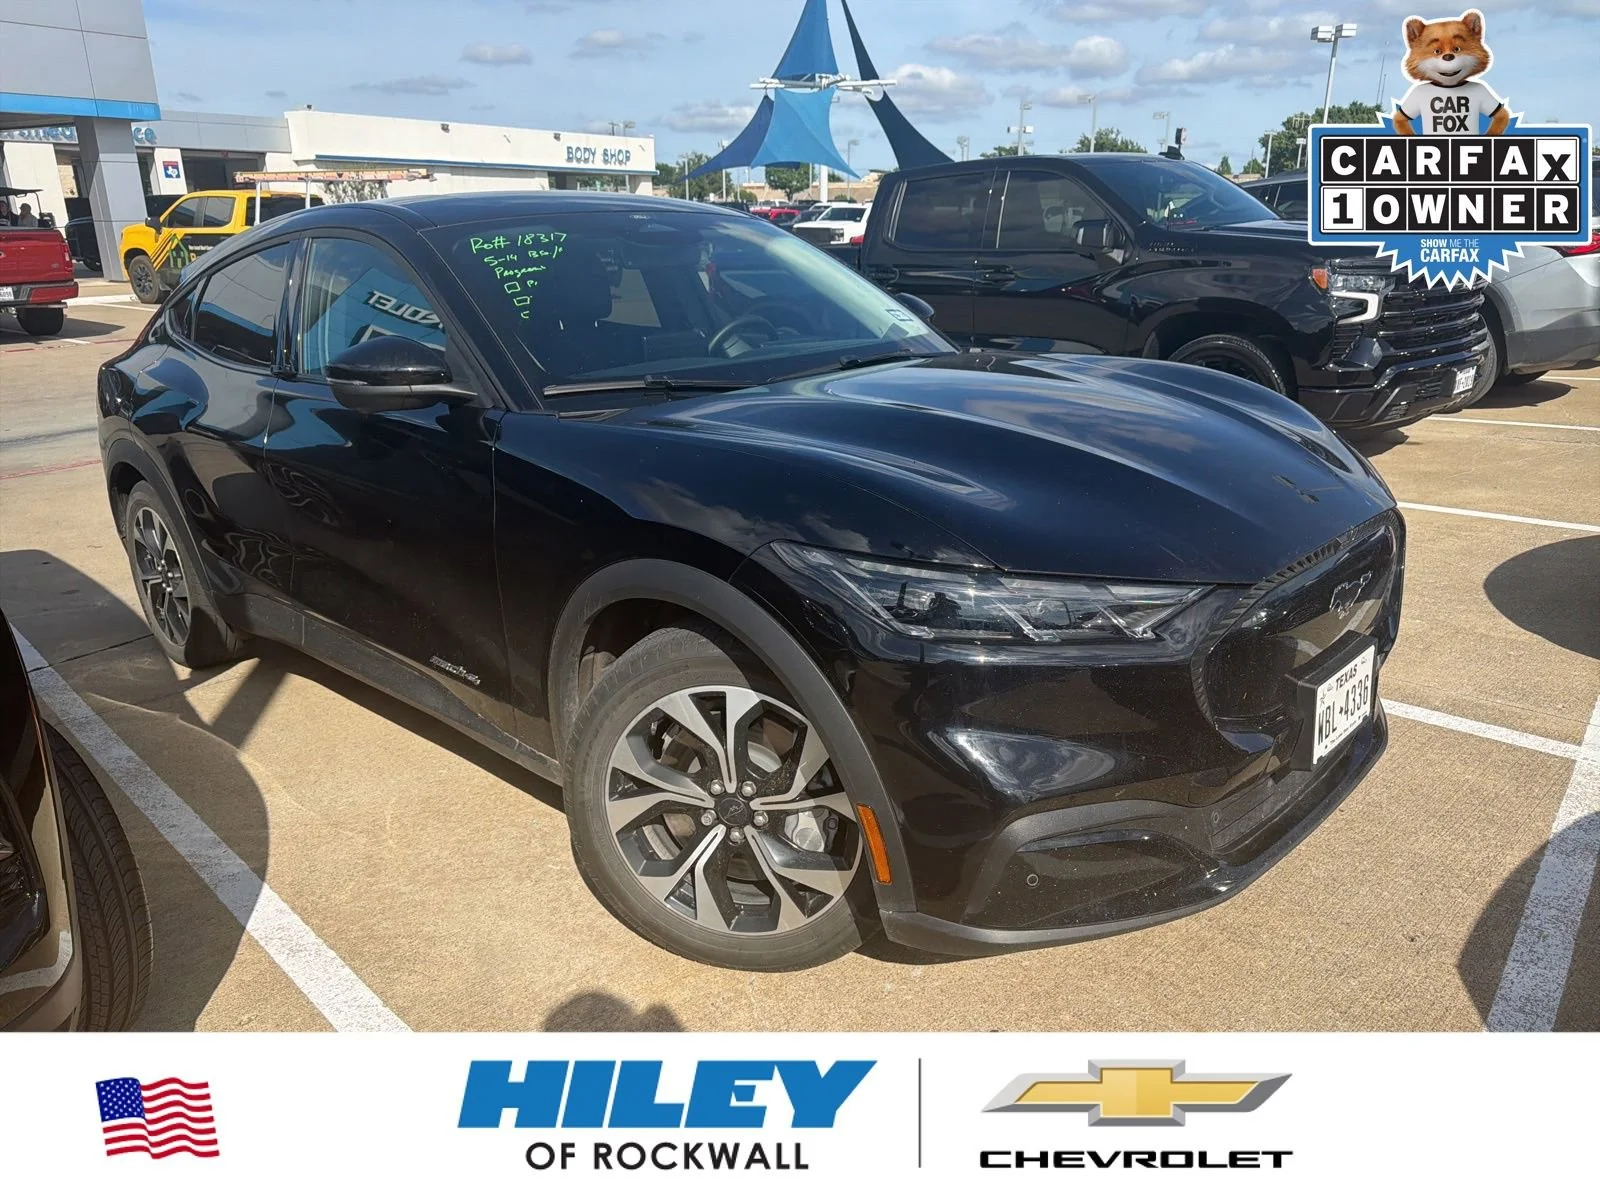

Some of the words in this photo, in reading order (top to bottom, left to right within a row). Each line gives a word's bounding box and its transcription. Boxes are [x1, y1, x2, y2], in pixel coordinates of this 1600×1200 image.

[566, 146, 597, 162] BODY
[602, 147, 631, 164] SHOP
[517, 232, 567, 247] 18317
[1336, 663, 1358, 691] TEXAS
